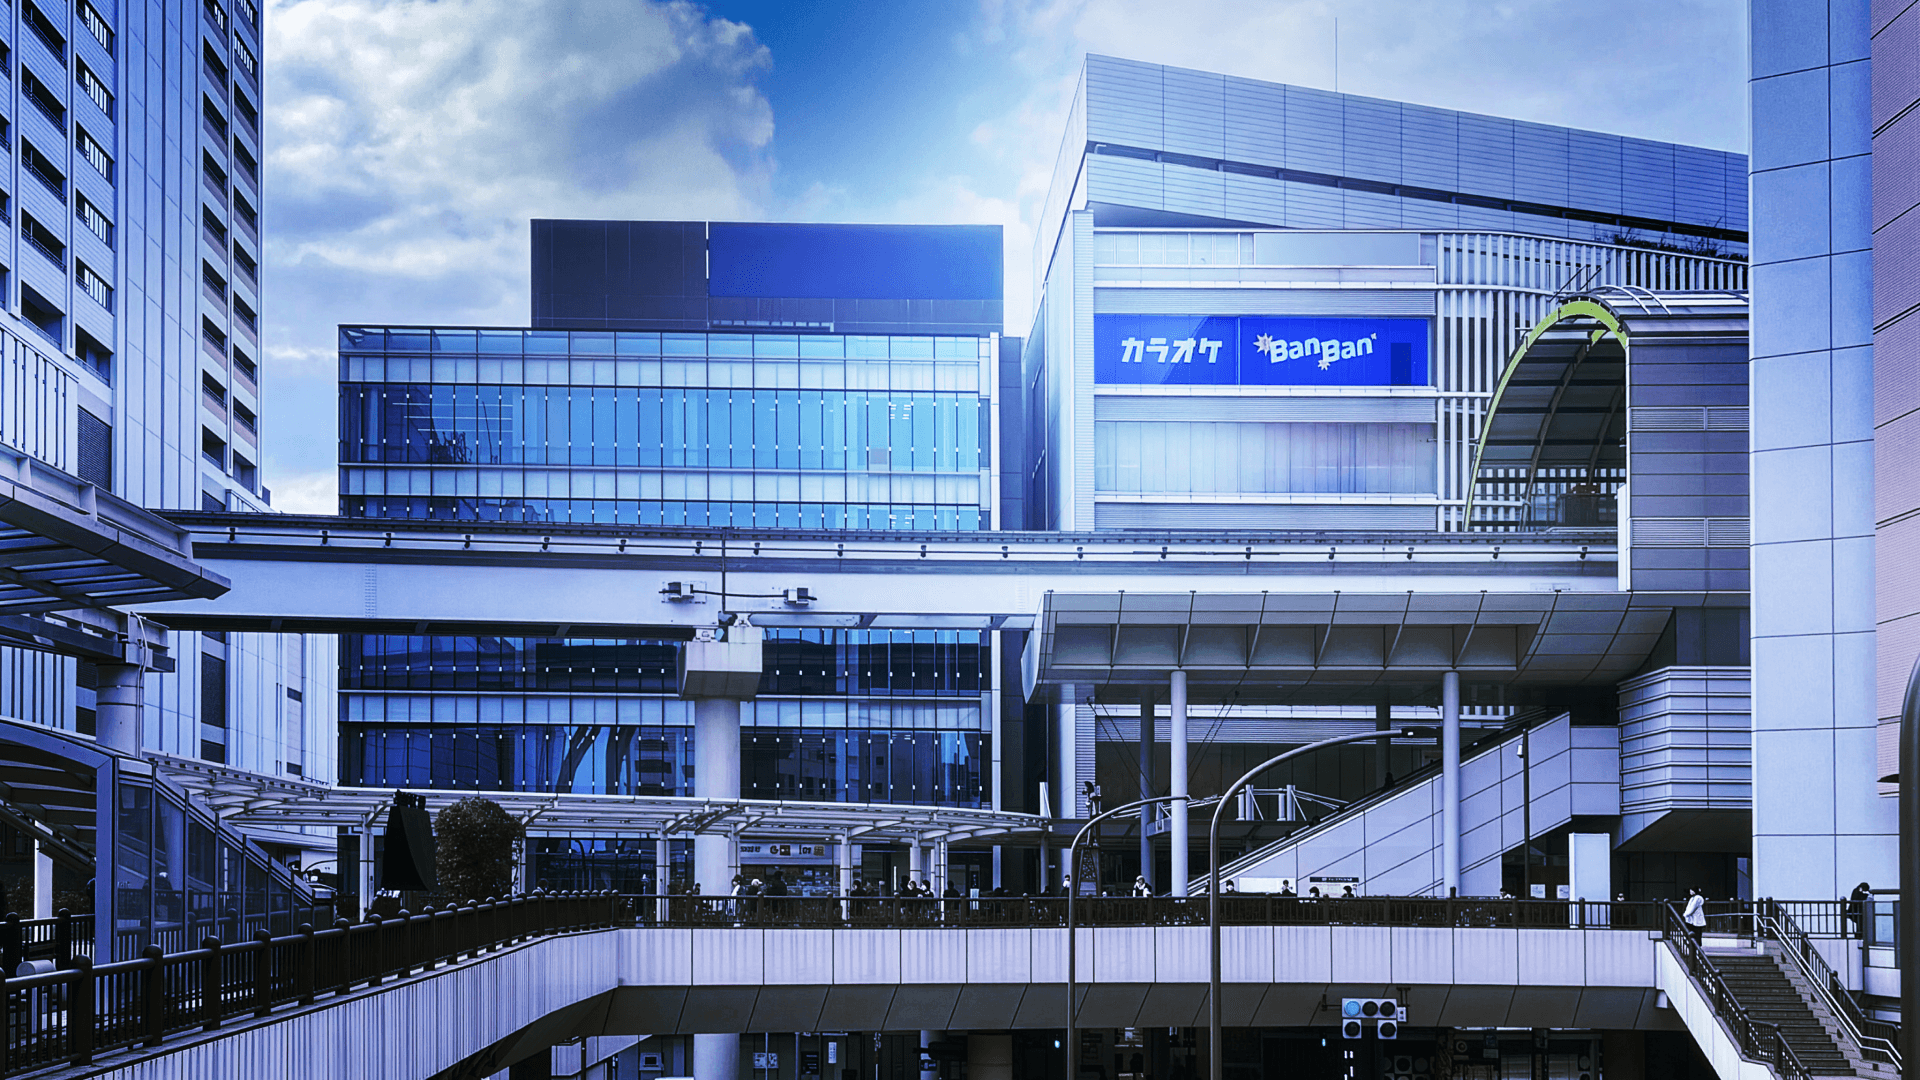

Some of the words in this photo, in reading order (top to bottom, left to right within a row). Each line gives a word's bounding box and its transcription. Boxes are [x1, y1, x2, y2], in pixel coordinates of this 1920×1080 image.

[1121, 337, 1223, 363] カラオケ
[1270, 338, 1373, 363] BanBan
